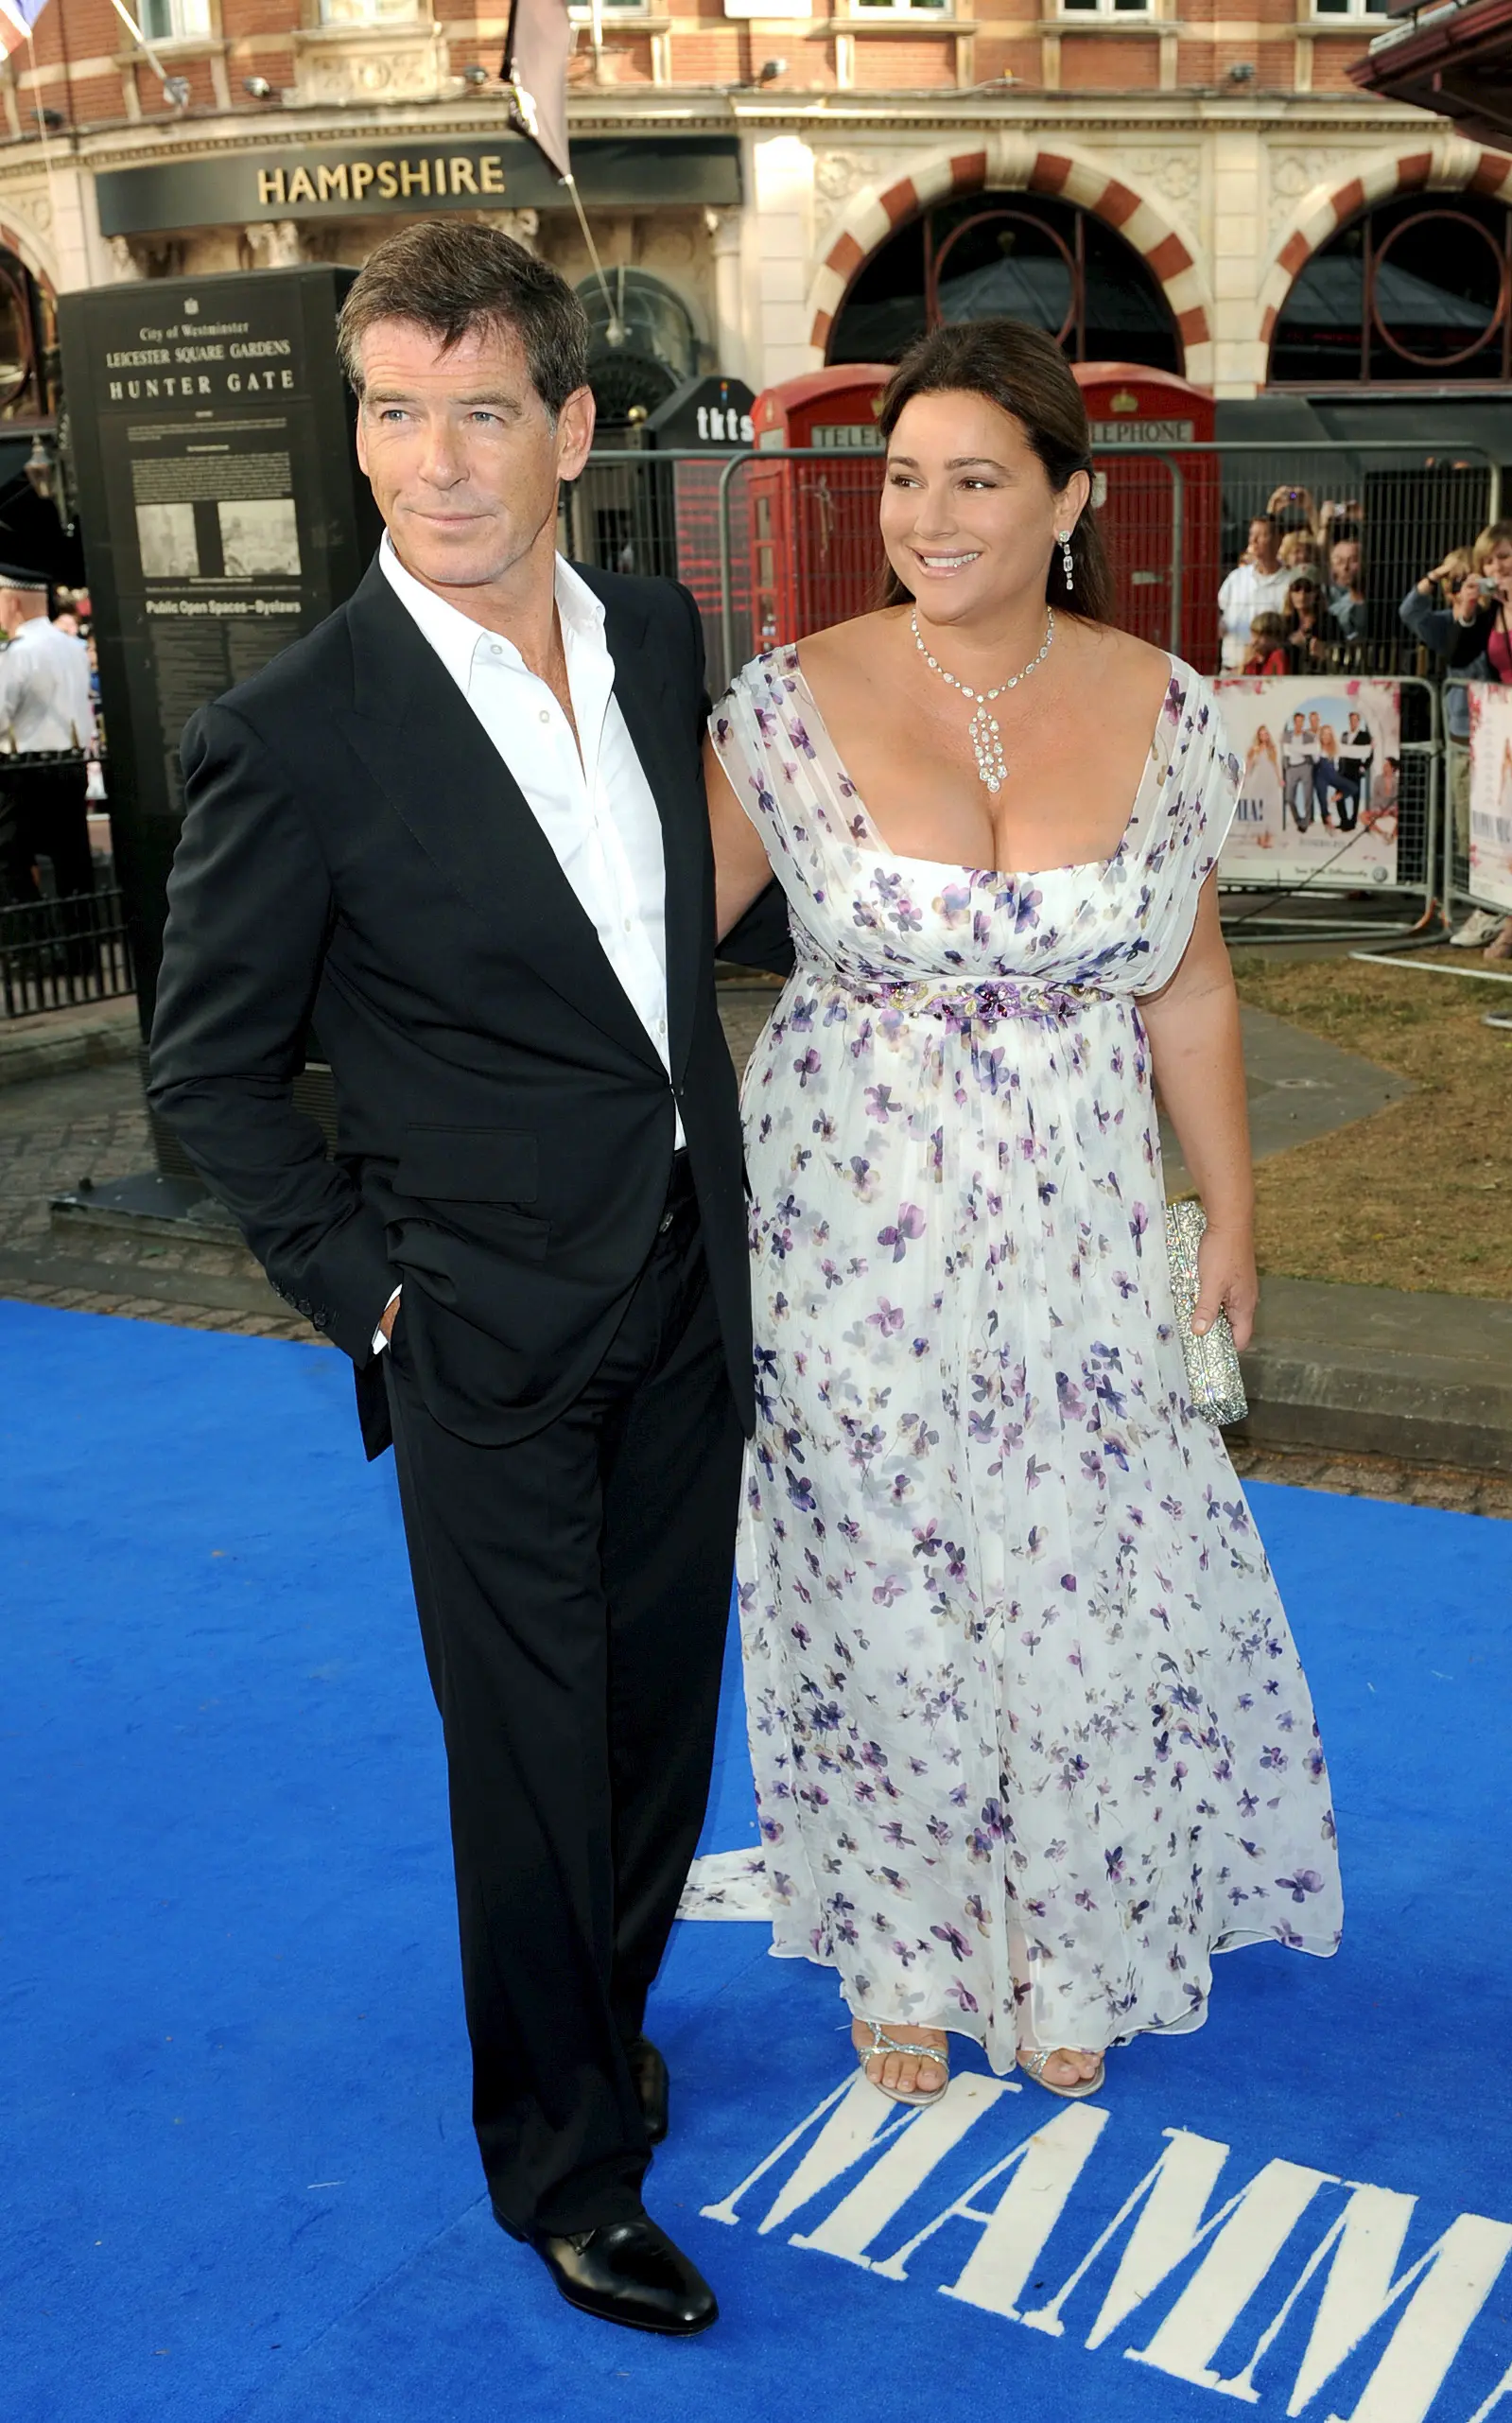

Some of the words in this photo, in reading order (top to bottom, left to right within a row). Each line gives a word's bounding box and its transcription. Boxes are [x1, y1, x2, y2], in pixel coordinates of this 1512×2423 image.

[257, 156, 505, 204] HAMPSHIRE
[139, 326, 163, 343] City
[165, 324, 179, 340] of
[181, 321, 249, 338] Westminster
[106, 349, 171, 368] LEICESTER
[175, 344, 225, 363] SQUARE
[230, 340, 291, 358] GARDENS
[110, 375, 212, 400] HUNTER
[227, 370, 294, 392] GATE
[697, 407, 755, 442] tkts
[146, 600, 179, 614] Public
[179, 600, 208, 616] Open
[699, 2068, 1512, 2423] MAMM
